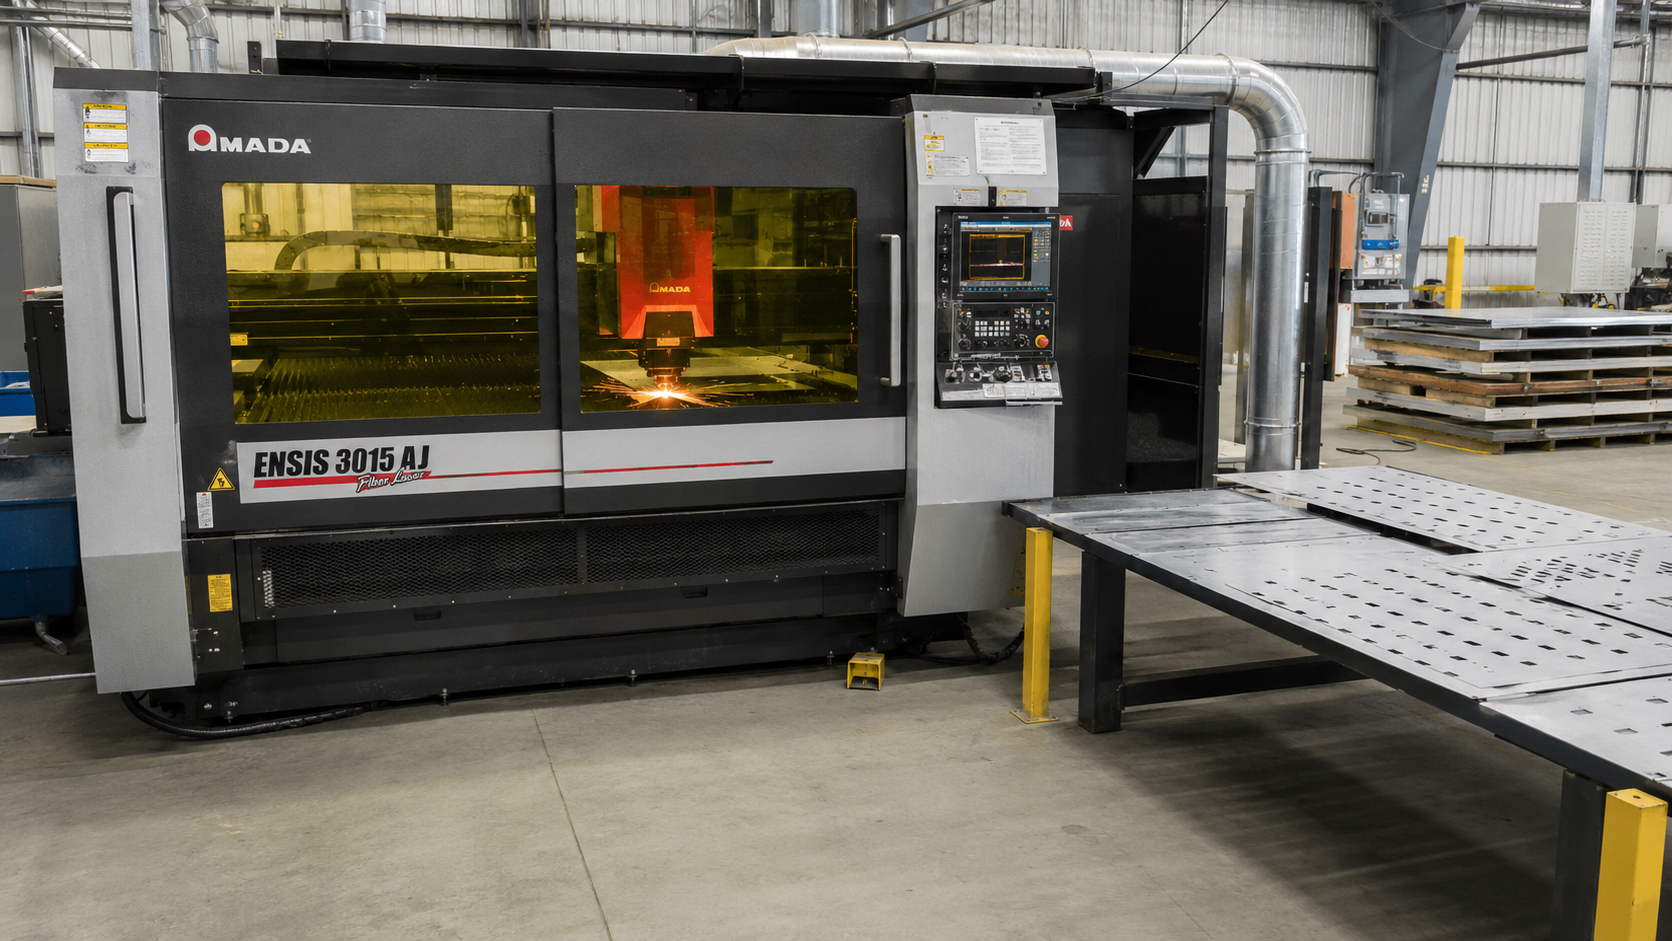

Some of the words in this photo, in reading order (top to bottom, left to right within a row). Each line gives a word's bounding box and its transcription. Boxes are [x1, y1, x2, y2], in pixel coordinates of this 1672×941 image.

[188, 124, 311, 154] AMADA
[649, 282, 691, 293] AMADA
[253, 449, 330, 478] ENSIS
[335, 446, 395, 475] 3015
[399, 445, 430, 471] AJ
